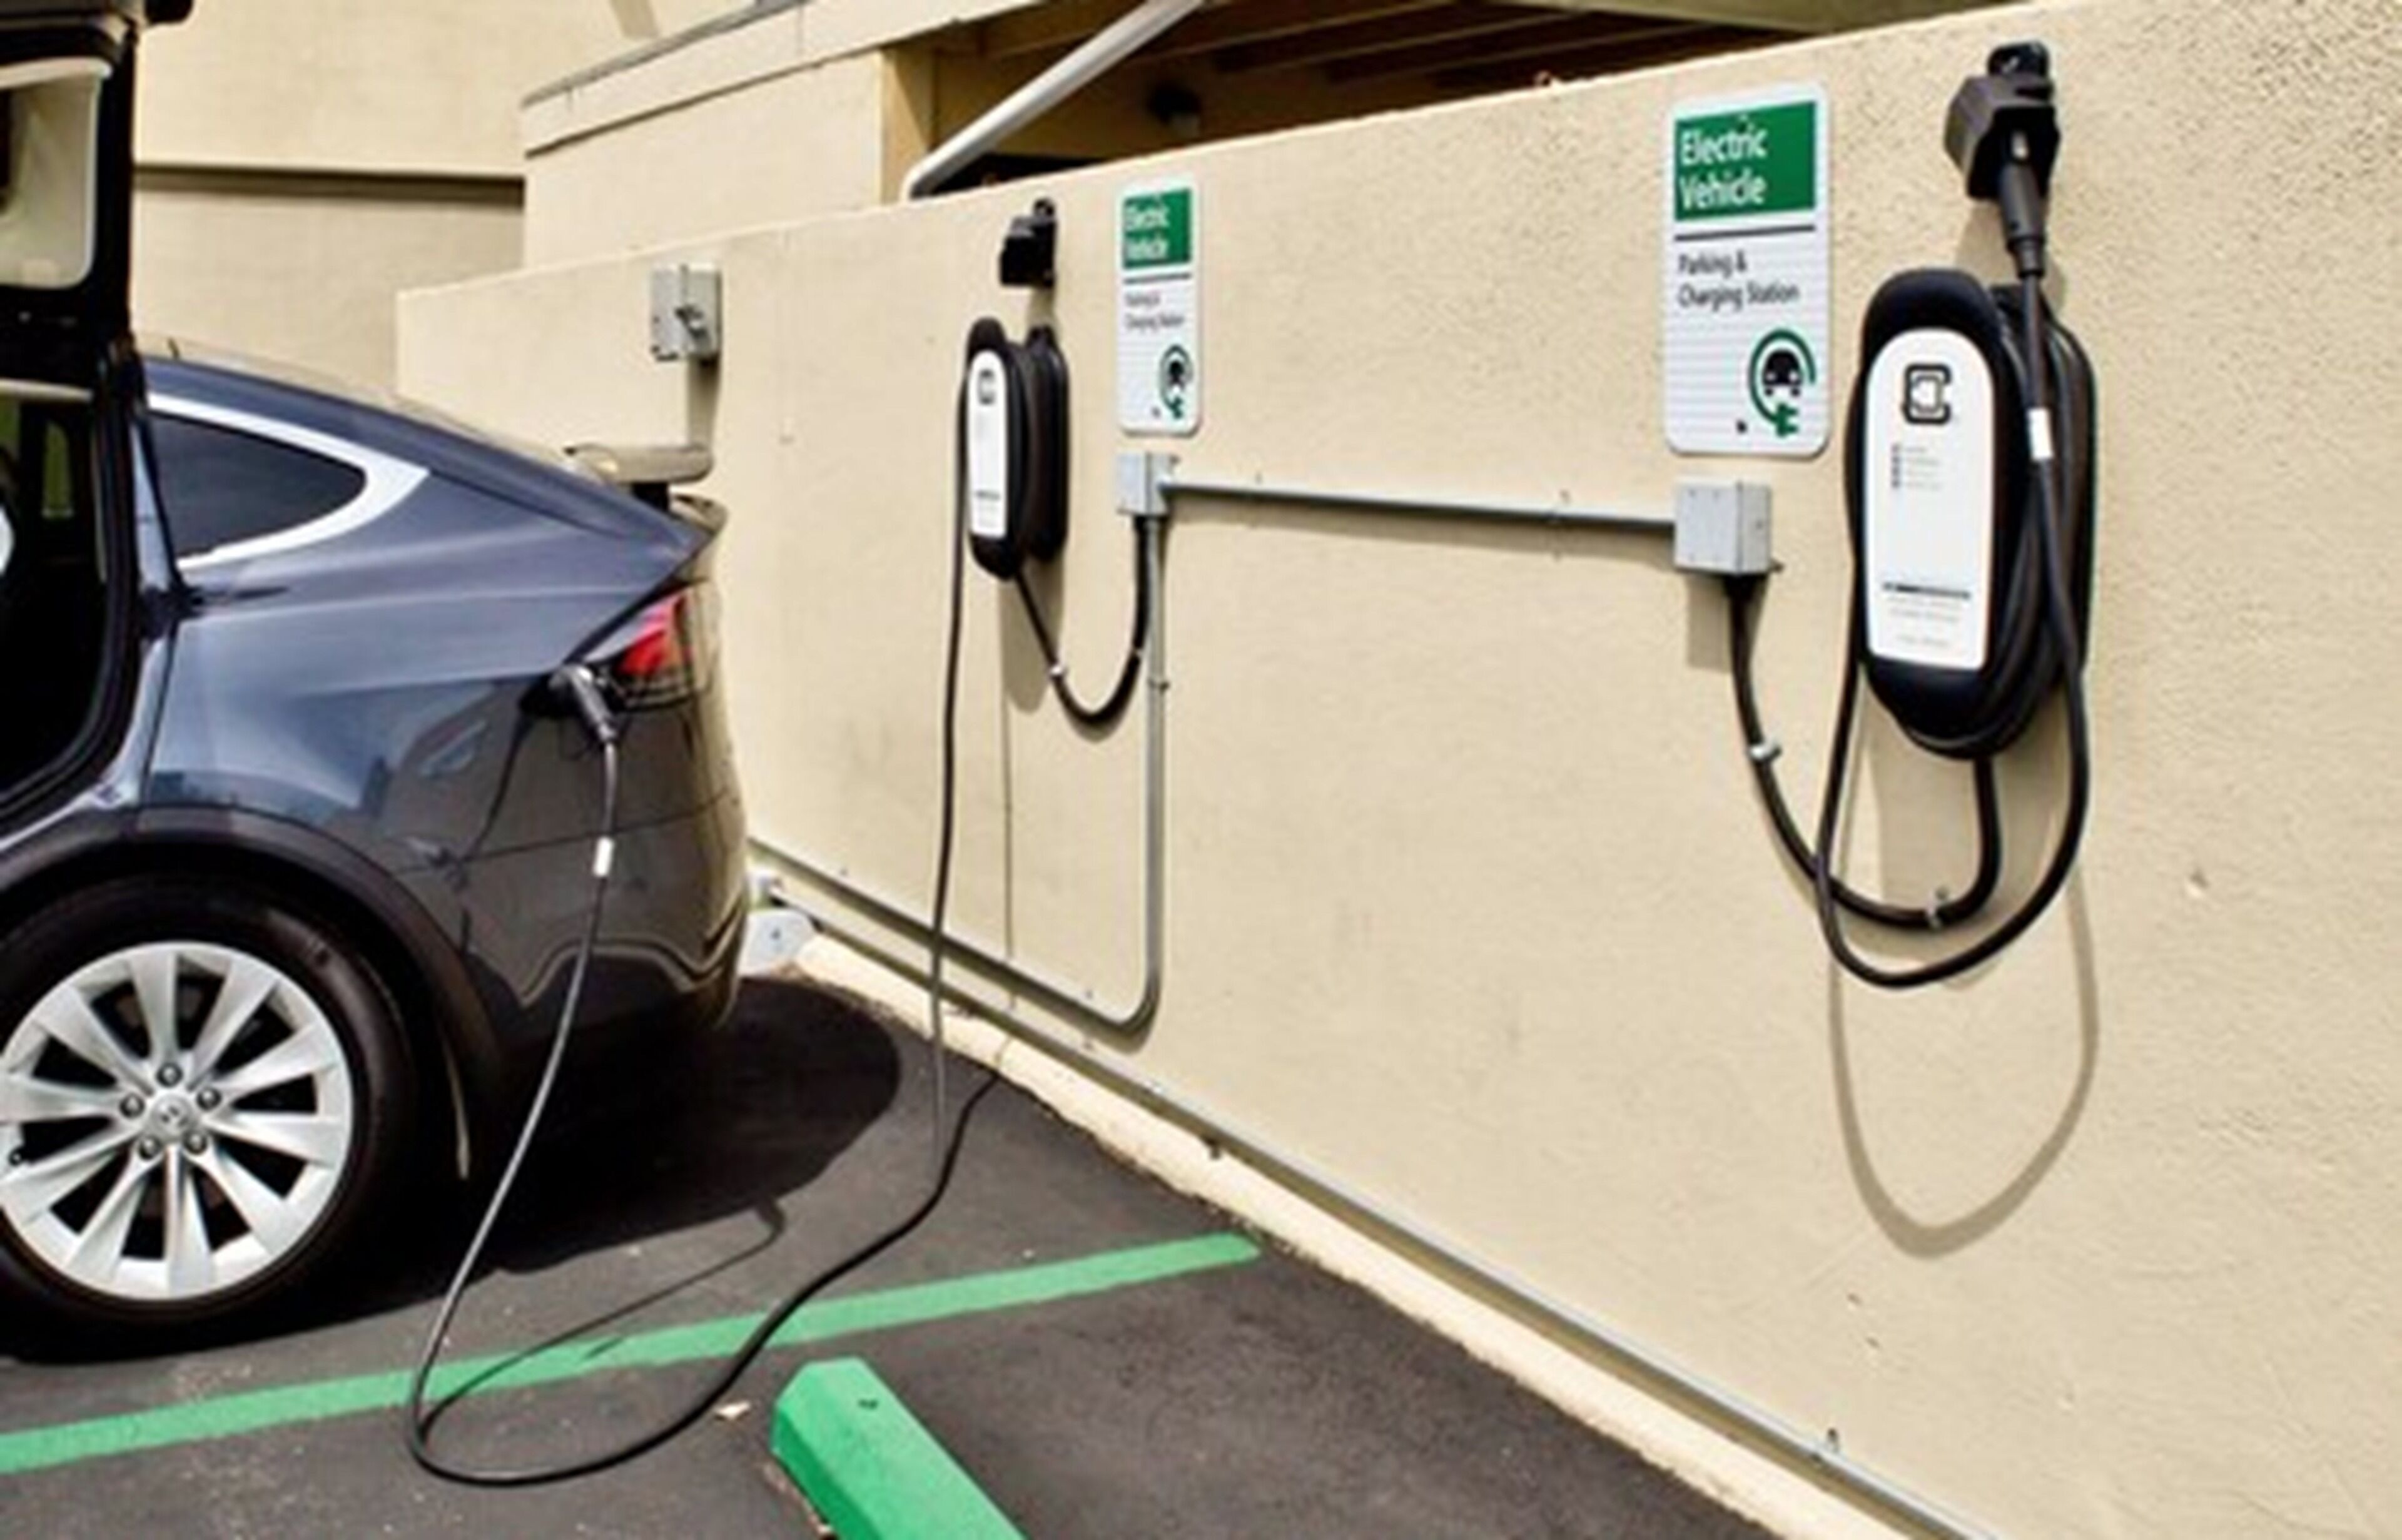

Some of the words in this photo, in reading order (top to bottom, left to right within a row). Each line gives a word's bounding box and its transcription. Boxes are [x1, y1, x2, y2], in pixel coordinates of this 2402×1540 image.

[1681, 122, 1768, 165] Electric
[1679, 169, 1767, 210] Vehicle
[1678, 252, 1732, 278] Parking
[1678, 283, 1743, 312] Charging
[1746, 280, 1800, 304] Station
